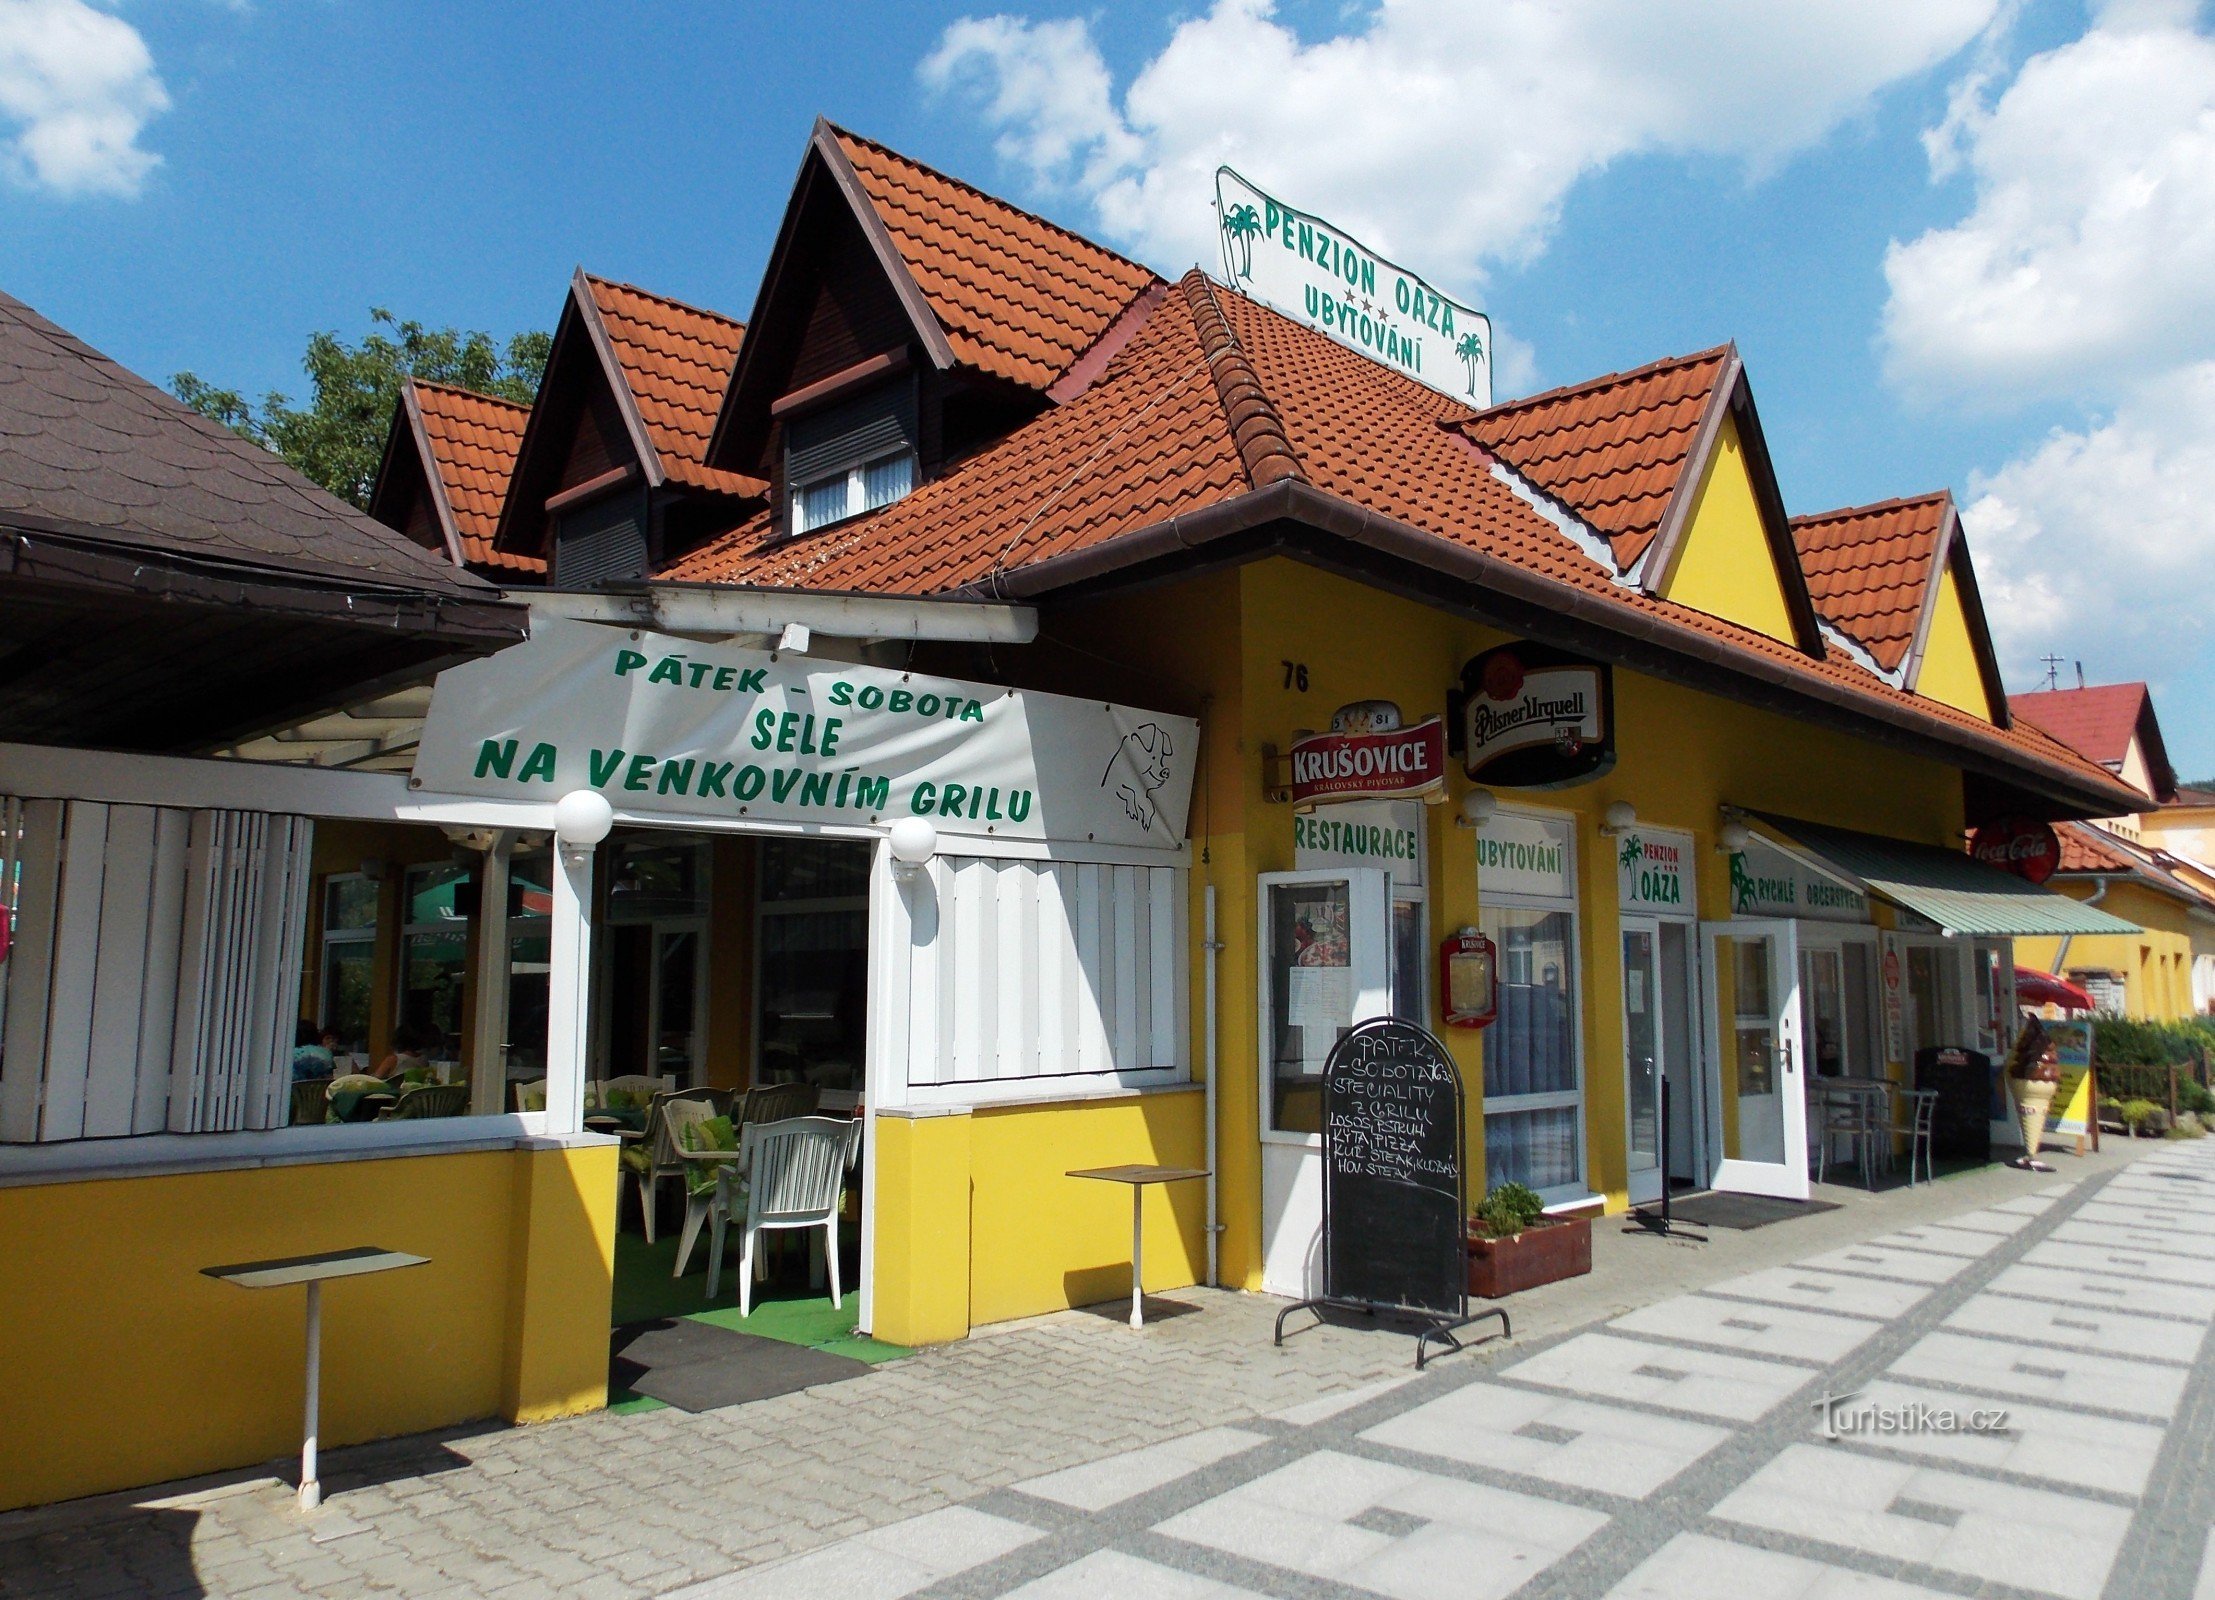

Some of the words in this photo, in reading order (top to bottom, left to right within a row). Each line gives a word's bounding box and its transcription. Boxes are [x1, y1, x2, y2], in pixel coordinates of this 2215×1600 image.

[1265, 200, 1375, 297] PENZION
[1305, 284, 1422, 373] UBYTOVÁNÍ
[615, 650, 768, 694] PÁTEK
[829, 681, 984, 722] SOBOTA
[1281, 659, 1309, 692] 76
[751, 708, 843, 757] SELE
[1475, 703, 1525, 747] Pilsner
[1524, 692, 1584, 726] Urquell
[474, 740, 556, 782] NA
[590, 749, 890, 811] VENKOVNÍM
[911, 781, 1031, 822] GRILU
[1294, 740, 1428, 784] KRUŠOVICE
[1314, 778, 1364, 792] KRÁLOVSKÝ
[1367, 776, 1406, 788] PIVOVAR
[1295, 816, 1416, 860] RESTAURACE
[1477, 838, 1563, 875] UBYTOVÁNÍ
[1643, 842, 1679, 863] PENZION
[1641, 865, 1680, 904] OÁZA
[1758, 876, 1795, 904] RYCHLÉ
[1333, 1077, 1435, 1104] SPECIALITY
[1369, 1101, 1432, 1125] GRILU
